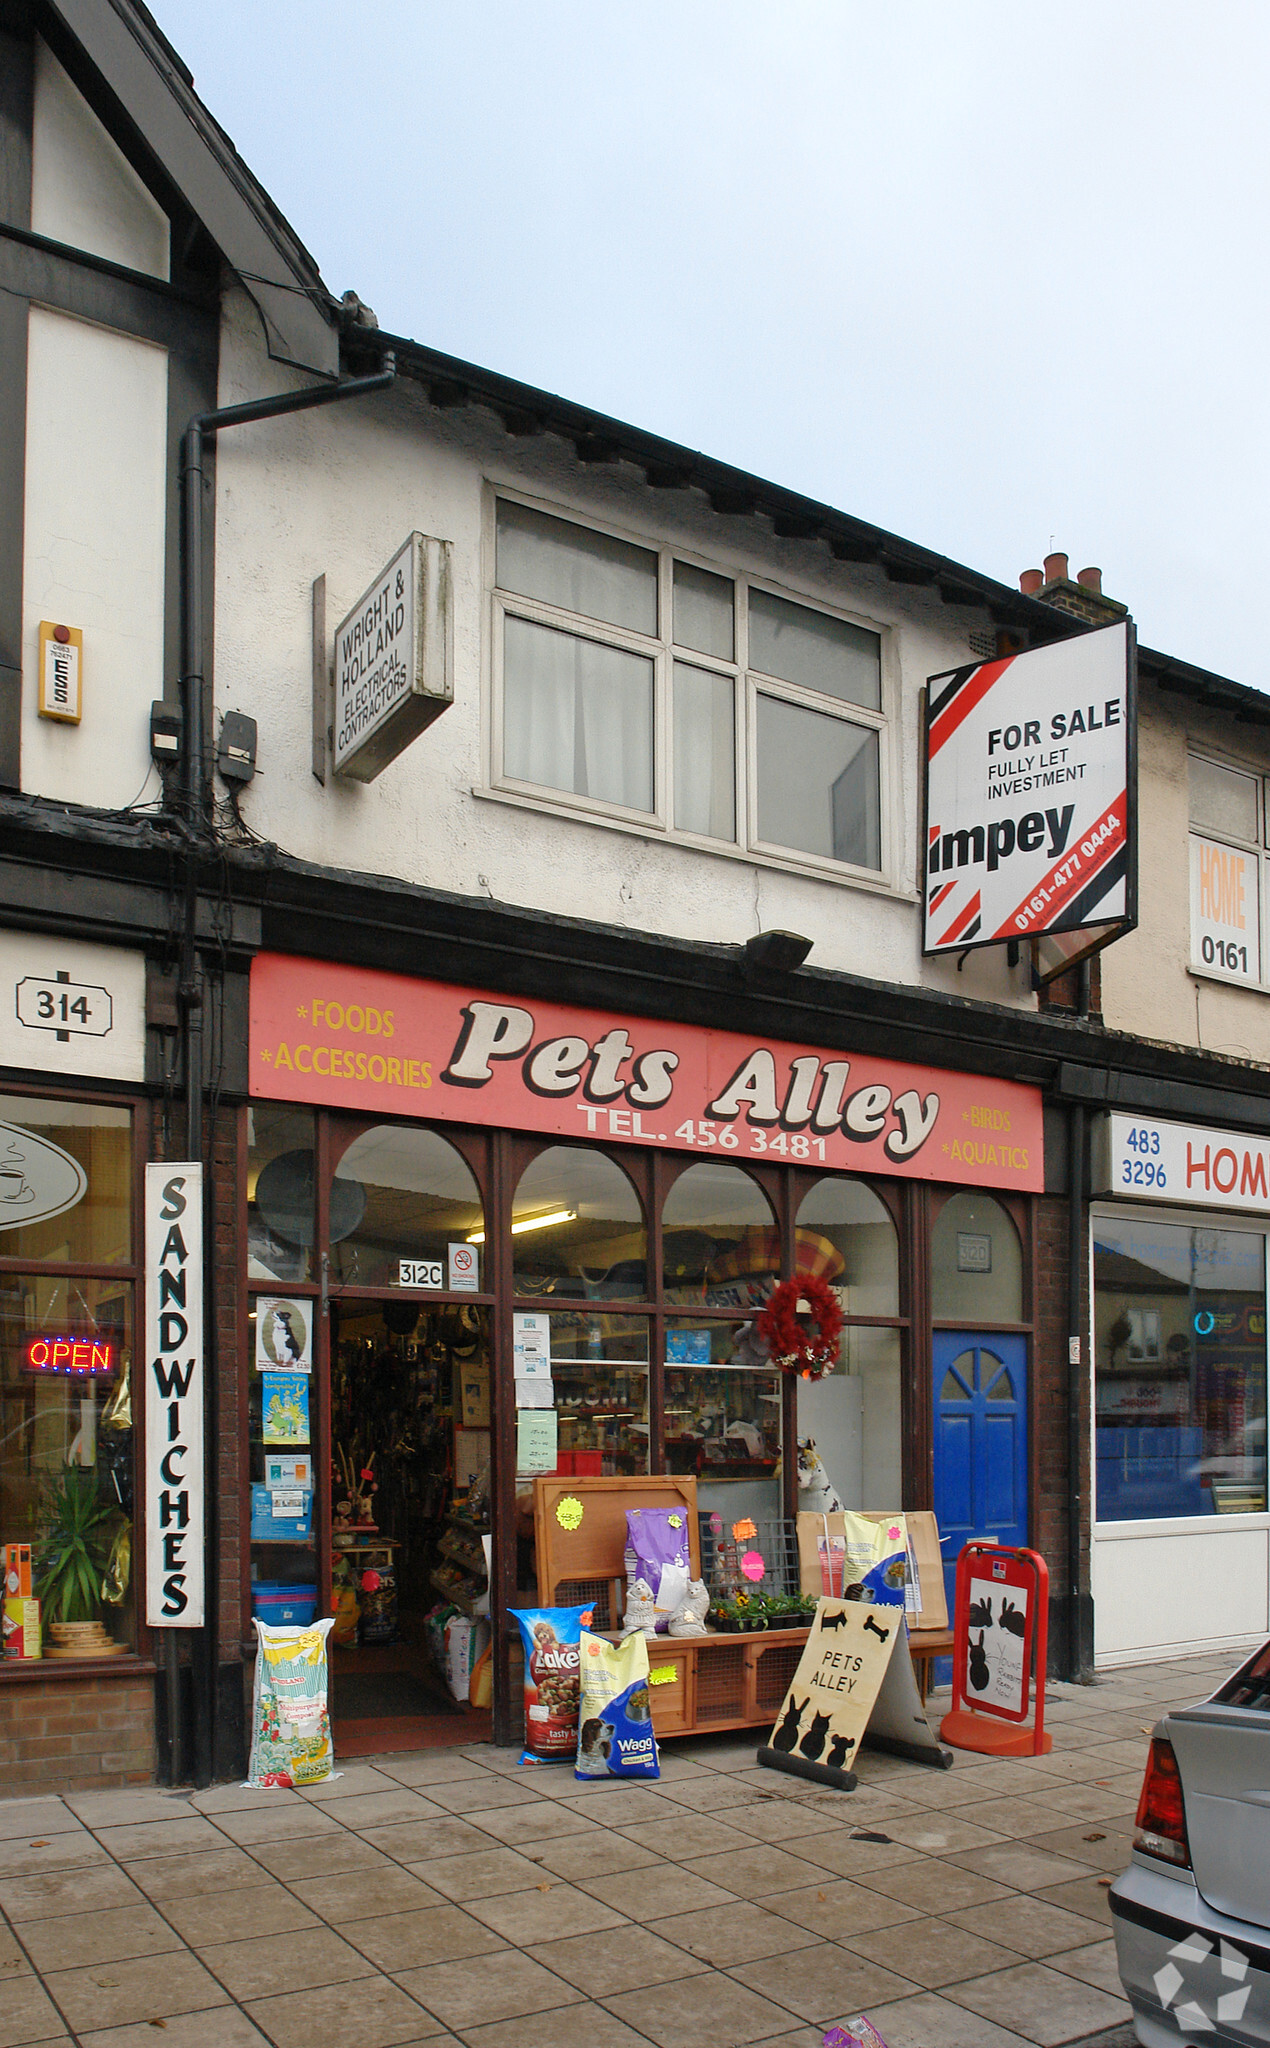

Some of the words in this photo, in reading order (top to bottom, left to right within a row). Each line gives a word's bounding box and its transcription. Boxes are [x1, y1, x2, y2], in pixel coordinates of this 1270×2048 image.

[343, 584, 390, 663] WRIGHT
[395, 569, 404, 600] &
[341, 603, 404, 697] HOLLAND
[54, 658, 68, 703] ESS
[345, 649, 401, 723] ELECTRICAL
[338, 664, 407, 750] CONTRACTORS
[988, 720, 1041, 755] FOR
[1050, 699, 1121, 740] SALE
[988, 756, 1036, 780] FULLY
[1040, 748, 1069, 768] LET
[988, 764, 1087, 800] INVESTMENT
[929, 804, 1076, 874] impey
[1015, 854, 1082, 930] 0161-477
[1080, 814, 1120, 858] 0444
[1201, 844, 1246, 930] HOME
[1201, 935, 1248, 973] 0161
[37, 990, 93, 1024] 314
[440, 1000, 680, 1110] Pets
[704, 1048, 940, 1163] Alley
[576, 1104, 667, 1141] TEL.
[675, 1119, 740, 1149] 456
[749, 1127, 827, 1161] 3481
[1127, 1127, 1161, 1155] 483
[1122, 1159, 1167, 1188] 3296
[1187, 1141, 1270, 1199] HOM
[401, 1264, 442, 1285] 312C
[30, 1342, 110, 1369] OPEN
[152, 1176, 196, 1618] SANDWICHES
[535, 1649, 580, 1669] Bake
[821, 1650, 863, 1673] PETS
[810, 1670, 857, 1694] ALLEY
[286, 1711, 314, 1719] Compost
[549, 1730, 568, 1739] tasty
[617, 1737, 652, 1752] Wagg
